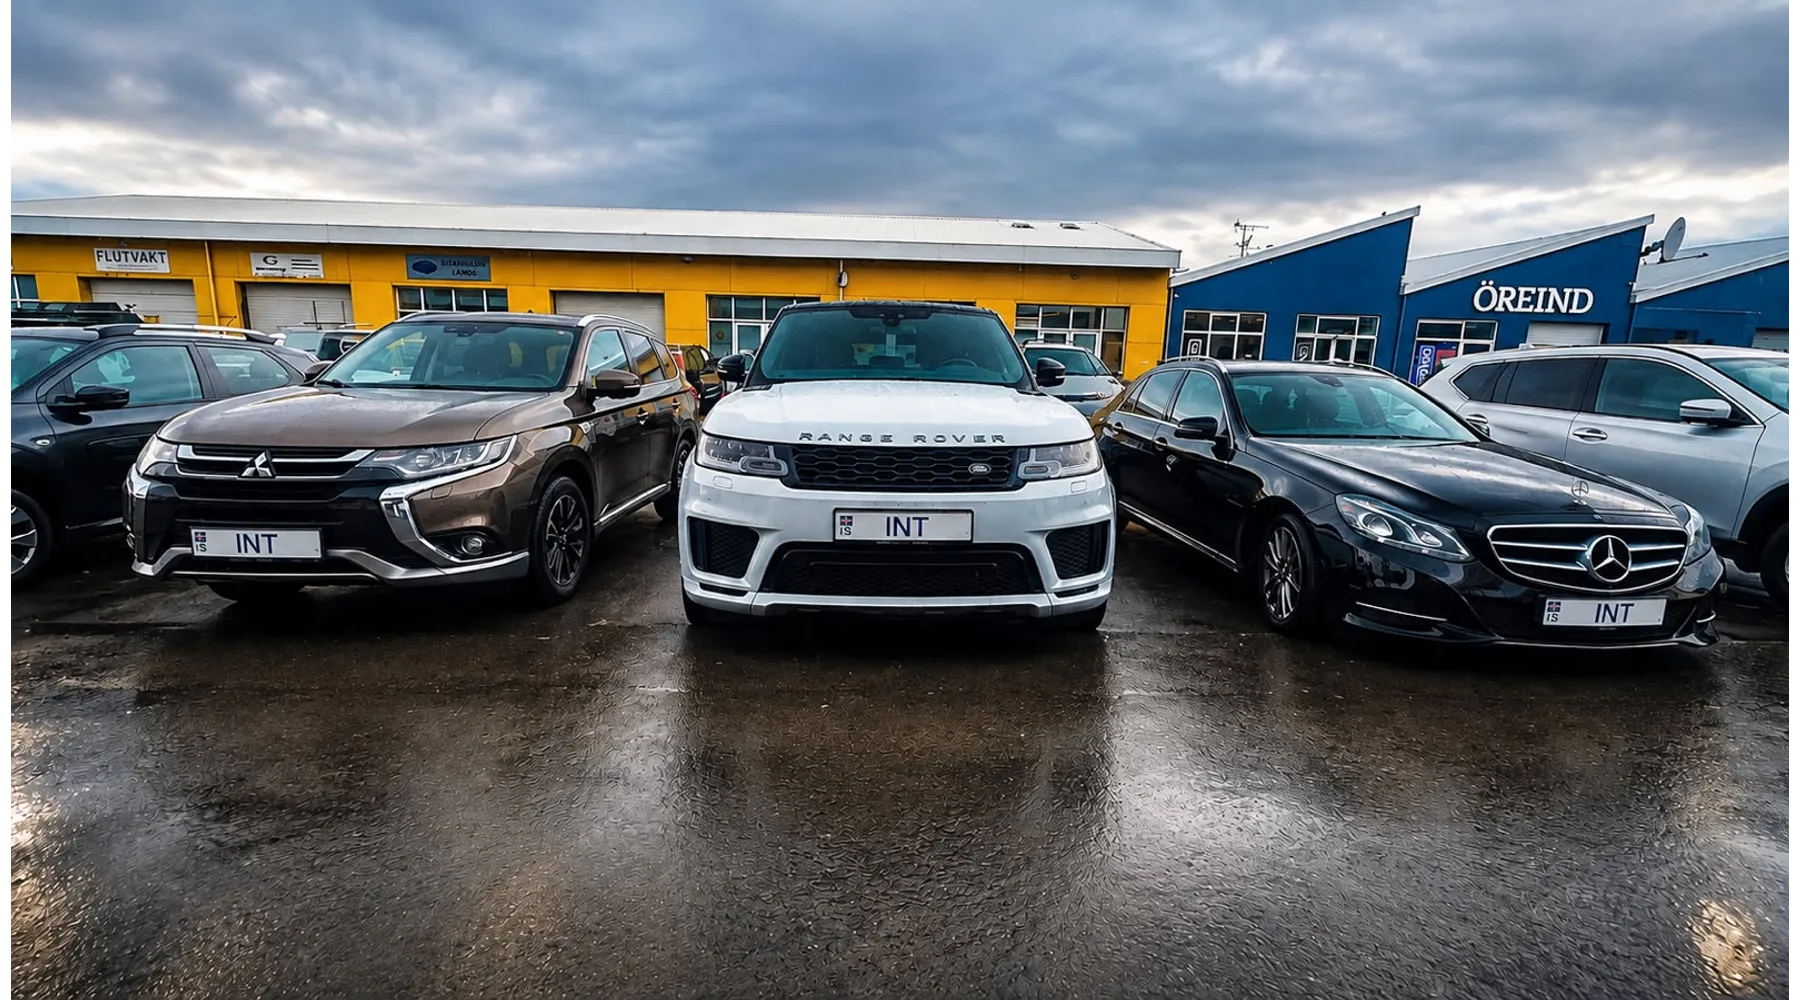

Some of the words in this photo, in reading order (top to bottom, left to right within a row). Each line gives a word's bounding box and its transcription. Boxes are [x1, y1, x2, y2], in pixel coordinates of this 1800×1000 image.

[96, 250, 166, 263] FLUTVAKT
[1473, 280, 1594, 314] ÖREIND
[799, 433, 893, 443] RANGE
[913, 434, 1006, 443] ROVER
[840, 526, 852, 535] IS
[886, 516, 929, 537] INT
[196, 543, 207, 552] IS
[236, 533, 278, 554] INT
[1547, 613, 1559, 622] IS
[1594, 603, 1635, 623] INT
